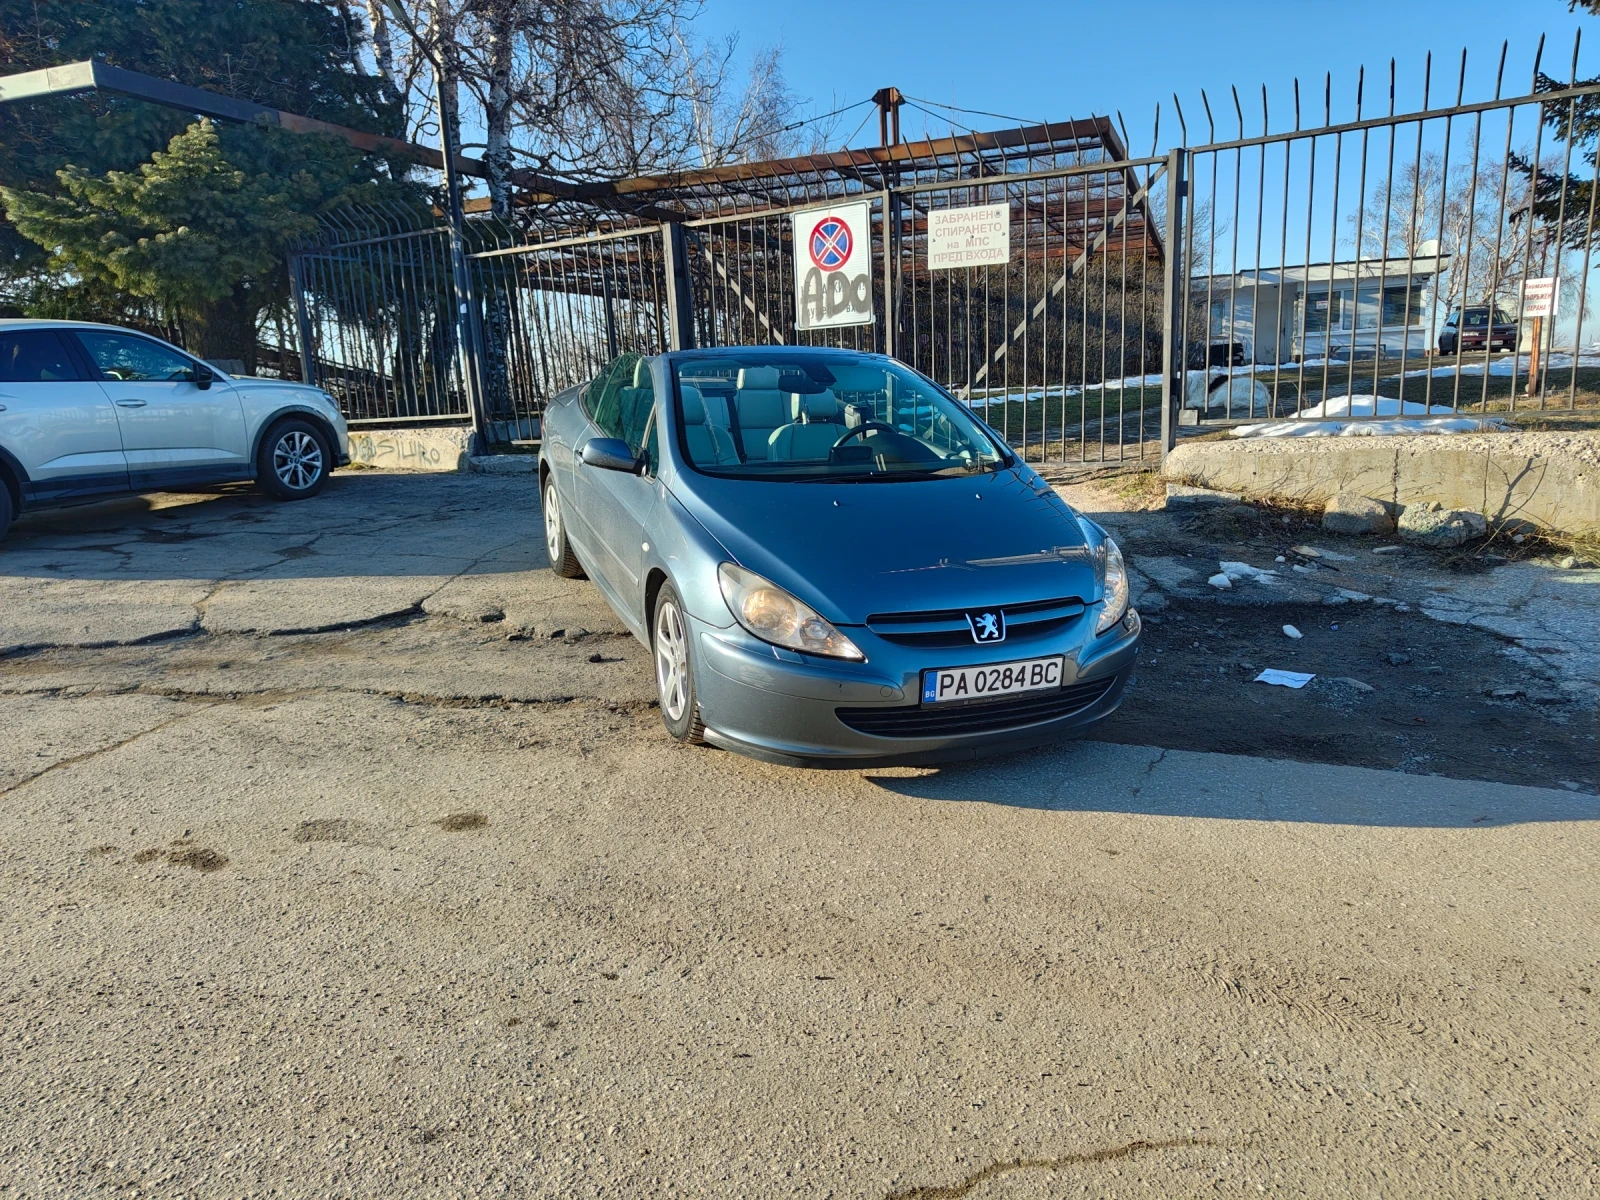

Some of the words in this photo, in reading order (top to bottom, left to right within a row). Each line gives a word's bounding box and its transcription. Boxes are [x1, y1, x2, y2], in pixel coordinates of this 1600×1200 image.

[935, 222, 1002, 238] СПИРАНЕТО
[947, 241, 960, 250] на
[965, 236, 990, 248] МПС
[933, 251, 963, 264] ПРЕД
[966, 248, 1004, 261] ВХОДА
[925, 690, 935, 698] BG
[939, 672, 969, 697] PA
[974, 665, 1026, 693] 0284
[1030, 661, 1059, 686] BC
